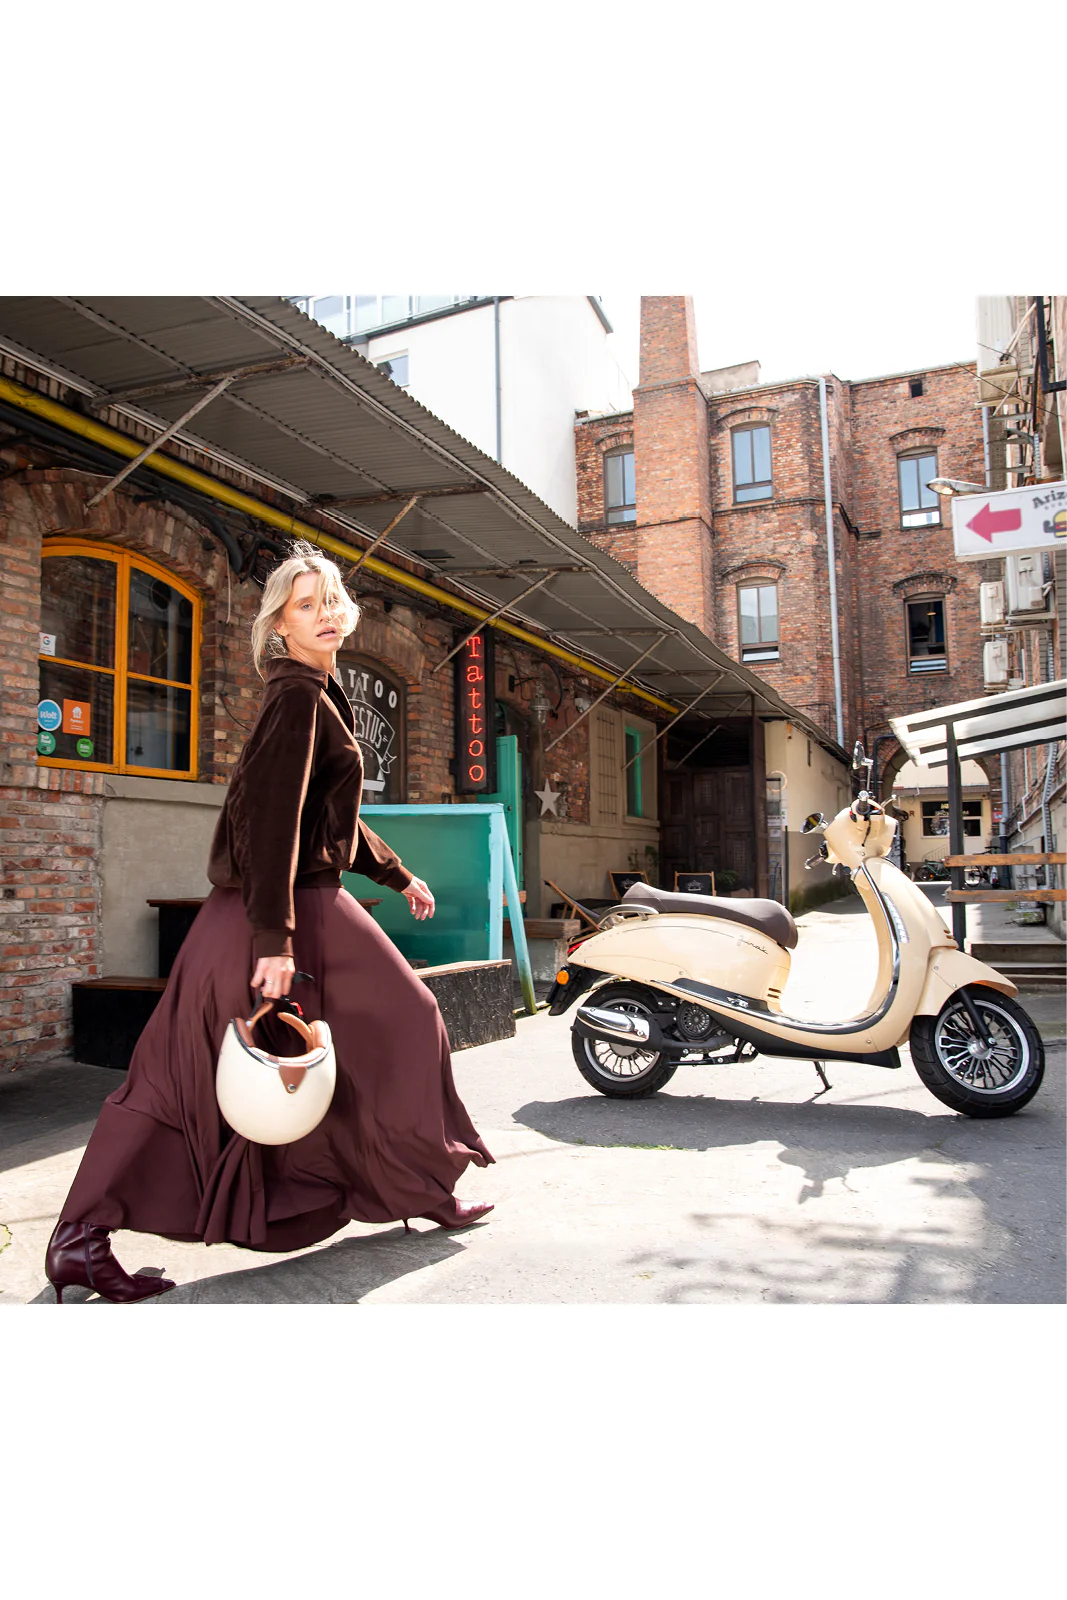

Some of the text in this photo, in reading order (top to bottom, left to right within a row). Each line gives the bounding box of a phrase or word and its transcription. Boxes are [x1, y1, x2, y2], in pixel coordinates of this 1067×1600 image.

[1032, 490, 1067, 509] Ariz
[335, 667, 398, 709] ATTOO
[466, 635, 485, 782] Tattoo
[353, 705, 386, 749] ESTUS
